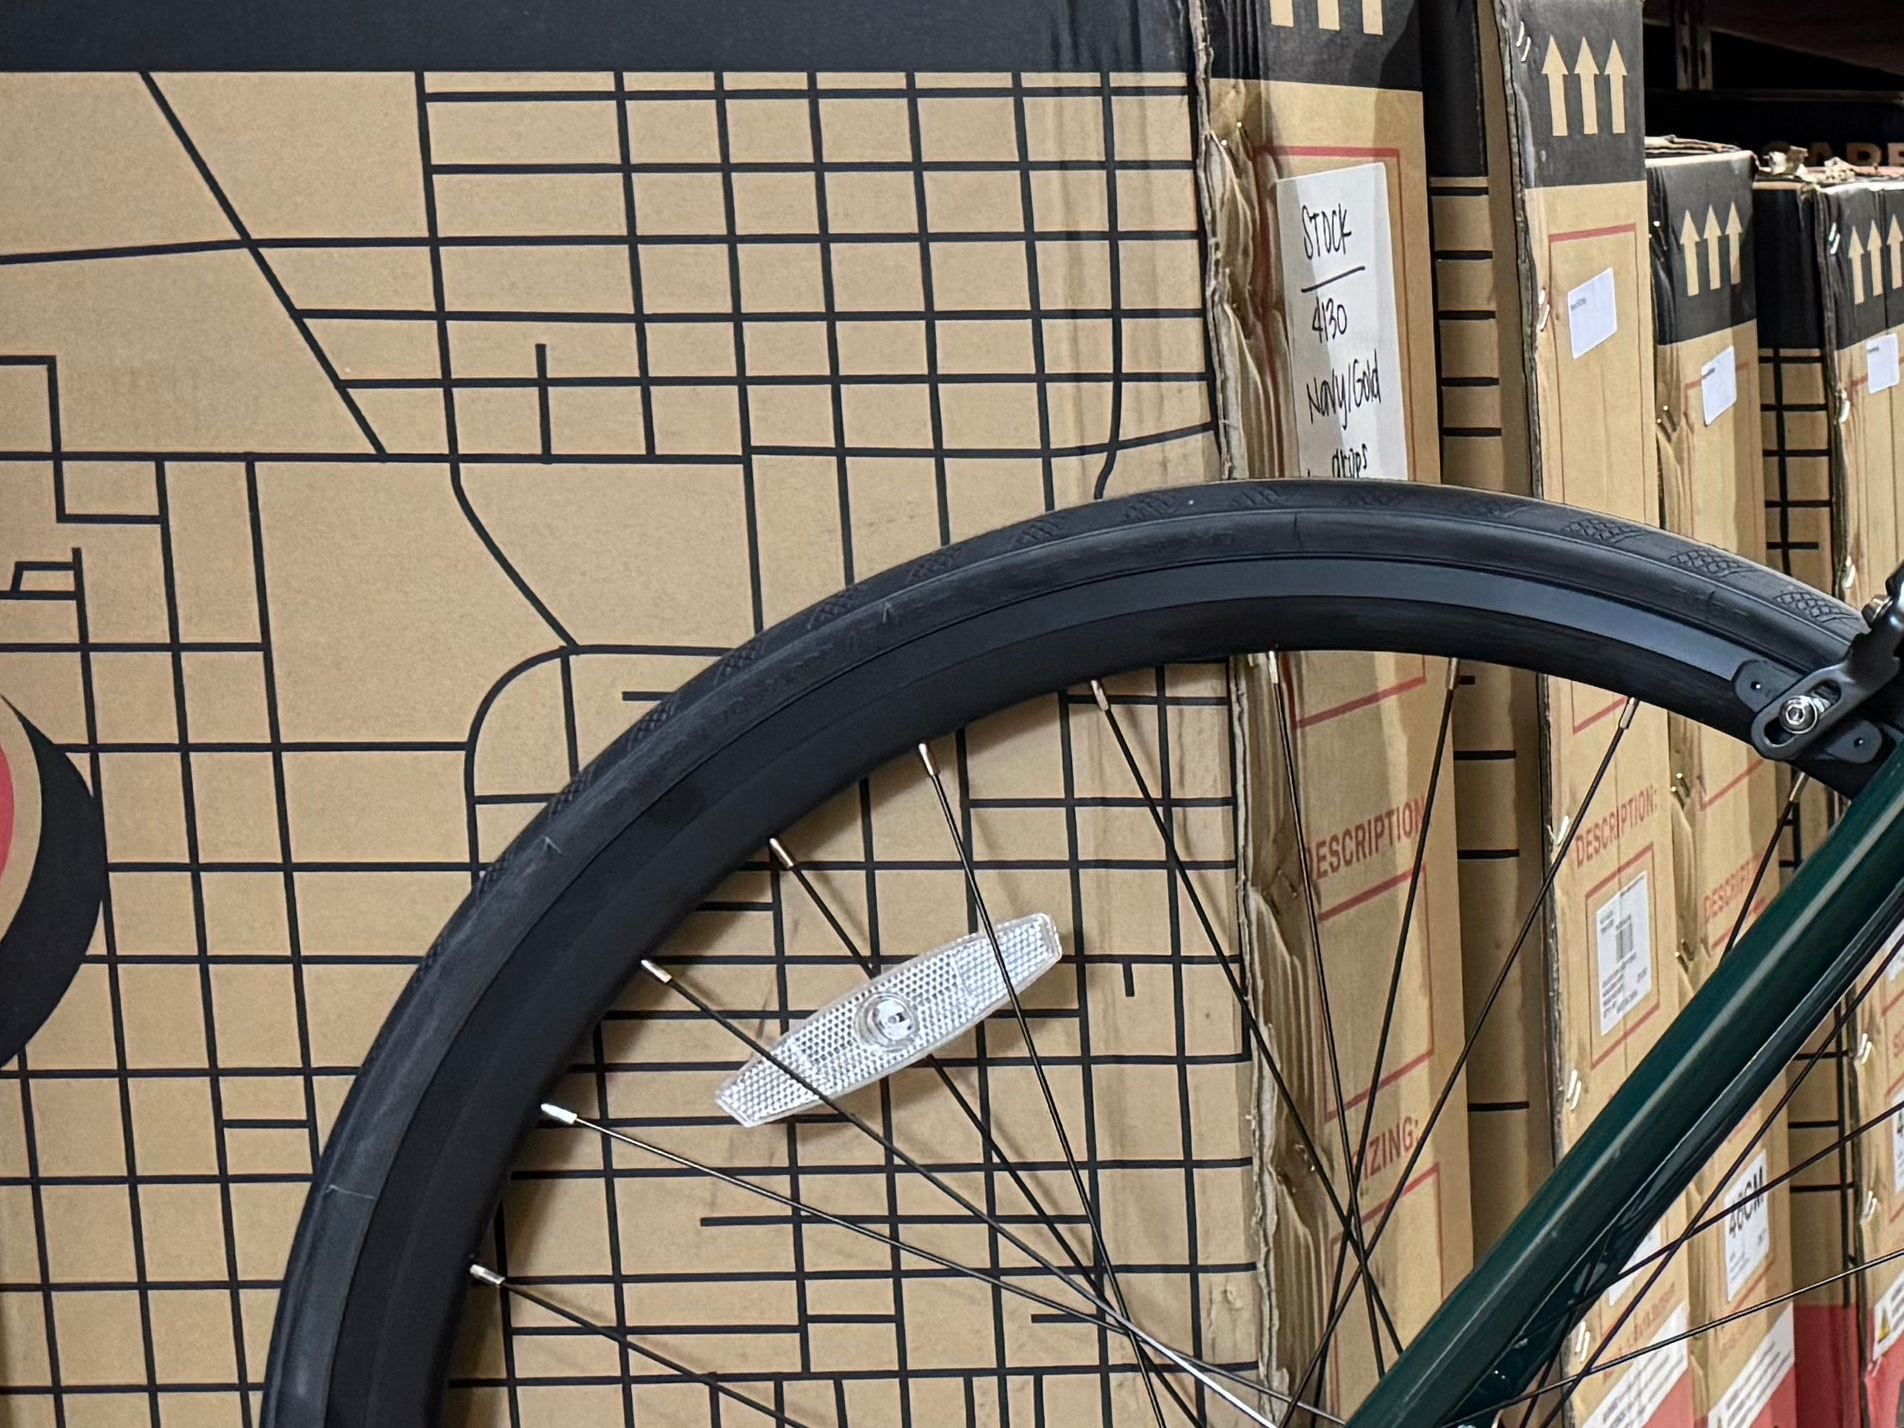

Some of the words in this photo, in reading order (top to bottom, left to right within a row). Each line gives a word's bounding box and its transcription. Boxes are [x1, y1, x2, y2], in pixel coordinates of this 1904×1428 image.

[1301, 203, 1351, 260] STOCK
[1311, 295, 1348, 344] 4130
[1575, 784, 1658, 869] DESCRIPTION:
